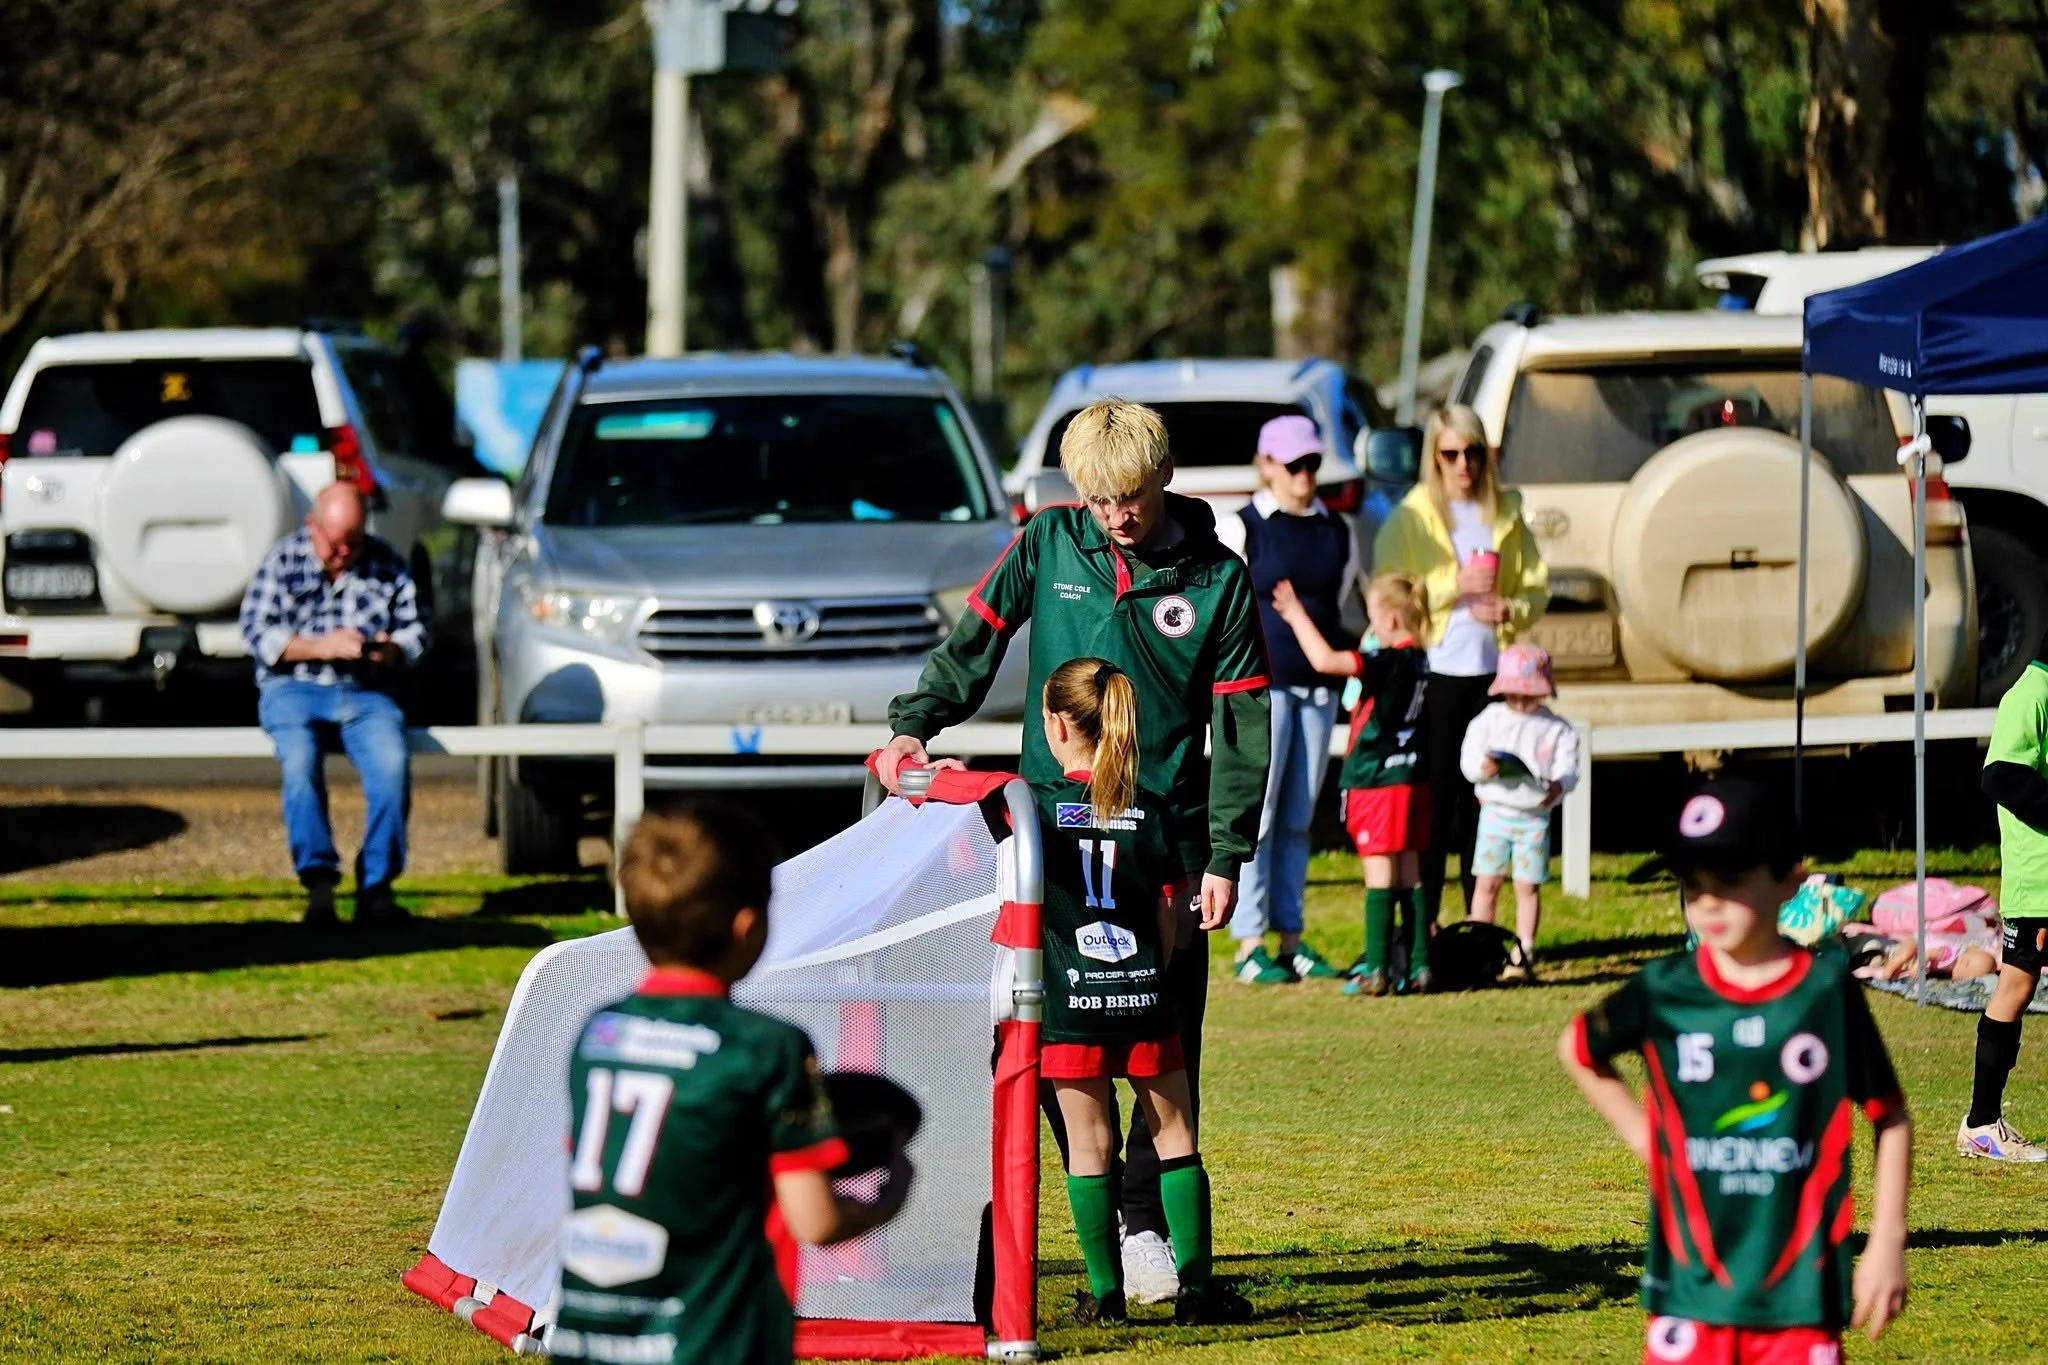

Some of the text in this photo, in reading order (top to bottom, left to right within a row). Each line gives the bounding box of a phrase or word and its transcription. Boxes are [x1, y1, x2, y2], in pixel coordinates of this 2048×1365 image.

[1053, 582, 1091, 594] STONE COLE
[1060, 592, 1082, 601] COACH
[1078, 838, 1117, 909] 11
[1068, 993, 1159, 1010] BOB BERRY
[1676, 1032, 1715, 1083] 15
[571, 1067, 675, 1196] 17
